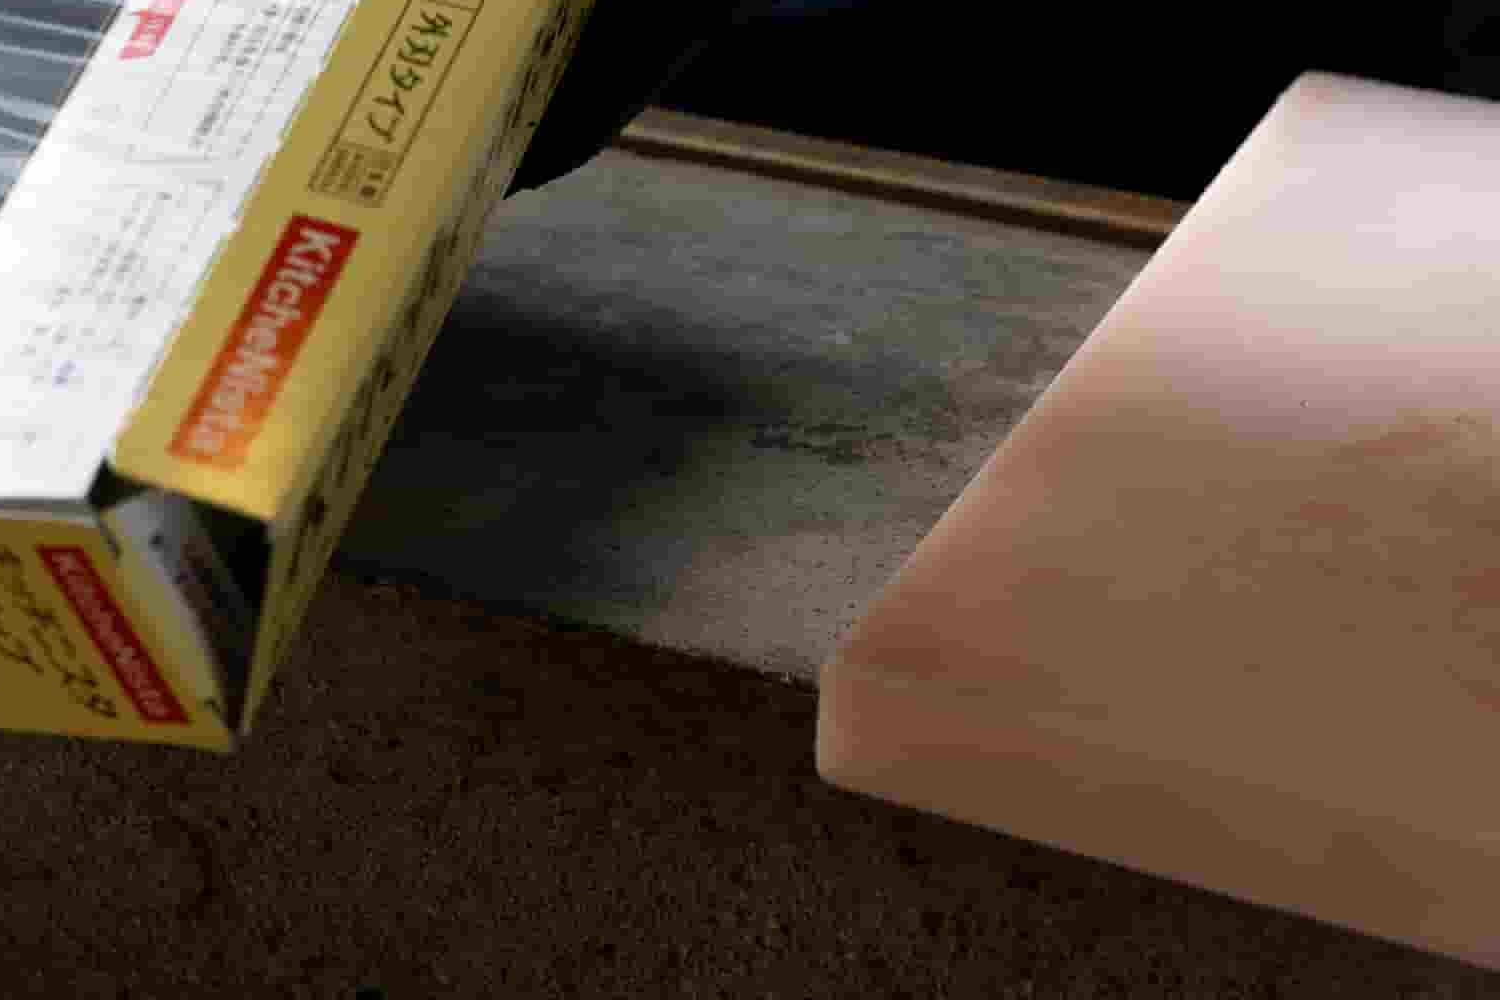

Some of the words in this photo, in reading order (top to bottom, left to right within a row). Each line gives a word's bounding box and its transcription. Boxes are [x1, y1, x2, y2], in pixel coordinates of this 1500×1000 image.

[367, 10, 454, 144] 外刃タイプ
